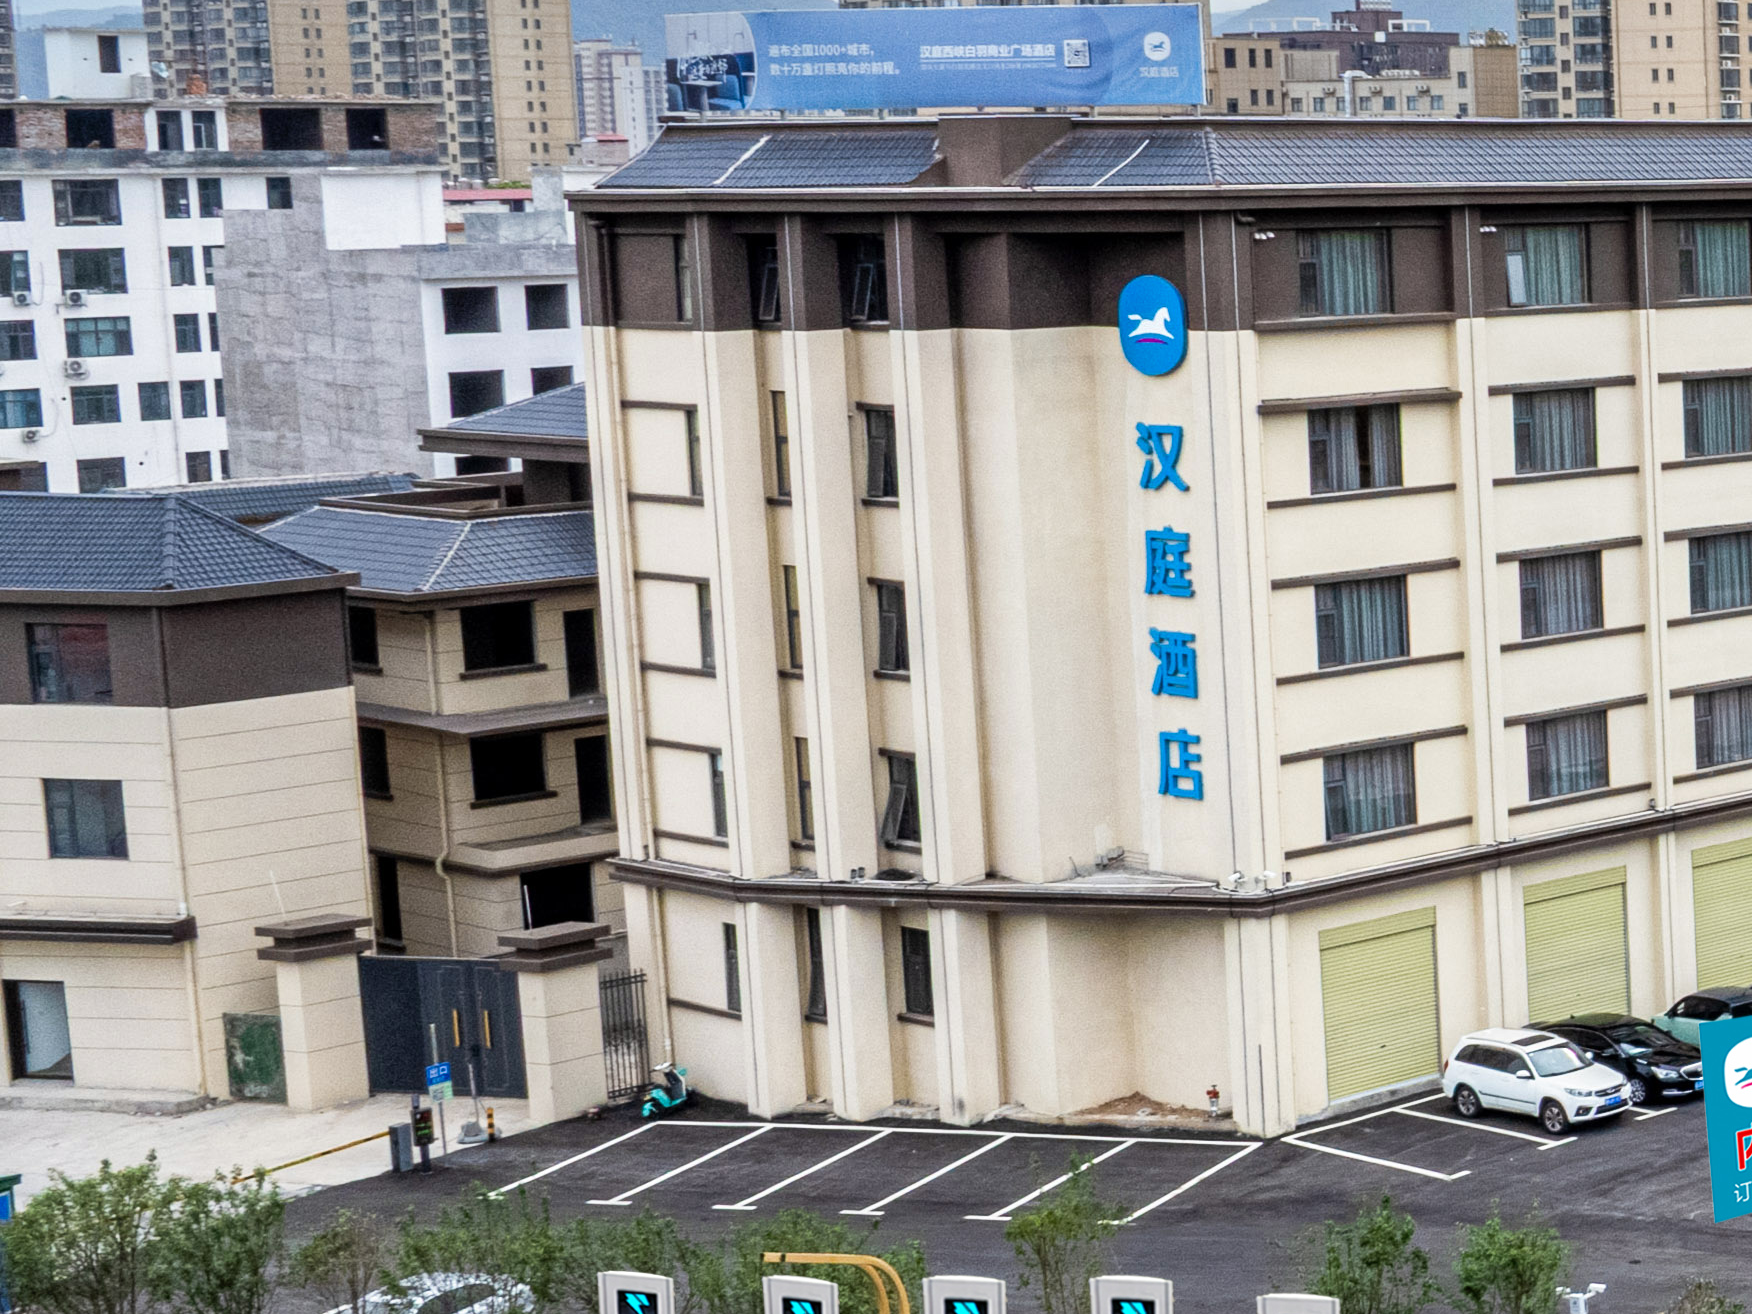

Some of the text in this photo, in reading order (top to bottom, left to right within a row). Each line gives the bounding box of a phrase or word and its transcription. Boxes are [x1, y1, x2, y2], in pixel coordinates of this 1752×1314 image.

[1140, 66, 1179, 78] 汉庭酒店
[1136, 422, 1203, 801] 汉庭酒店
